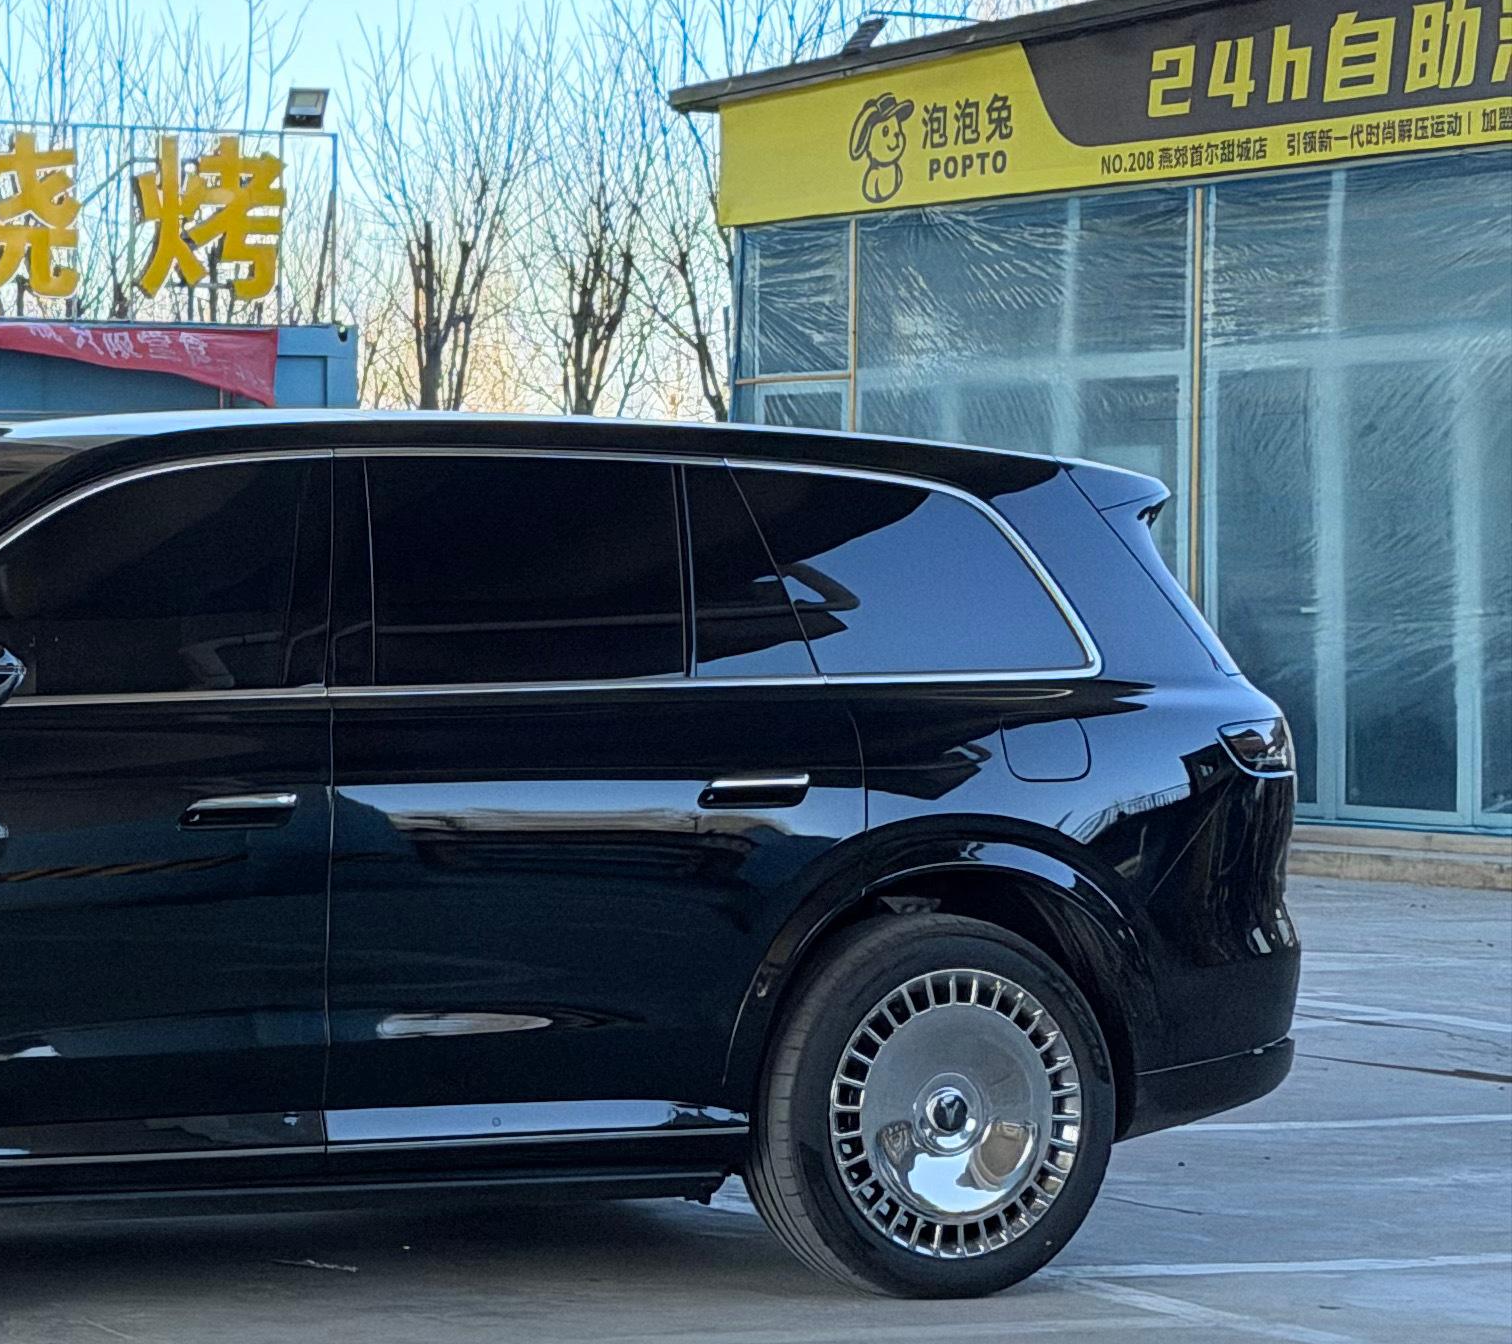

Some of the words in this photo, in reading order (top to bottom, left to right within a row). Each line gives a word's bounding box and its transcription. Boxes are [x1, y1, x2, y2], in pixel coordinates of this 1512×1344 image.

[922, 93, 1013, 149] 泡泡兔
[1286, 111, 1463, 156] 引领新一代时尚解压运动
[928, 150, 1007, 181] POPTO
[1101, 150, 1155, 175] NO.208
